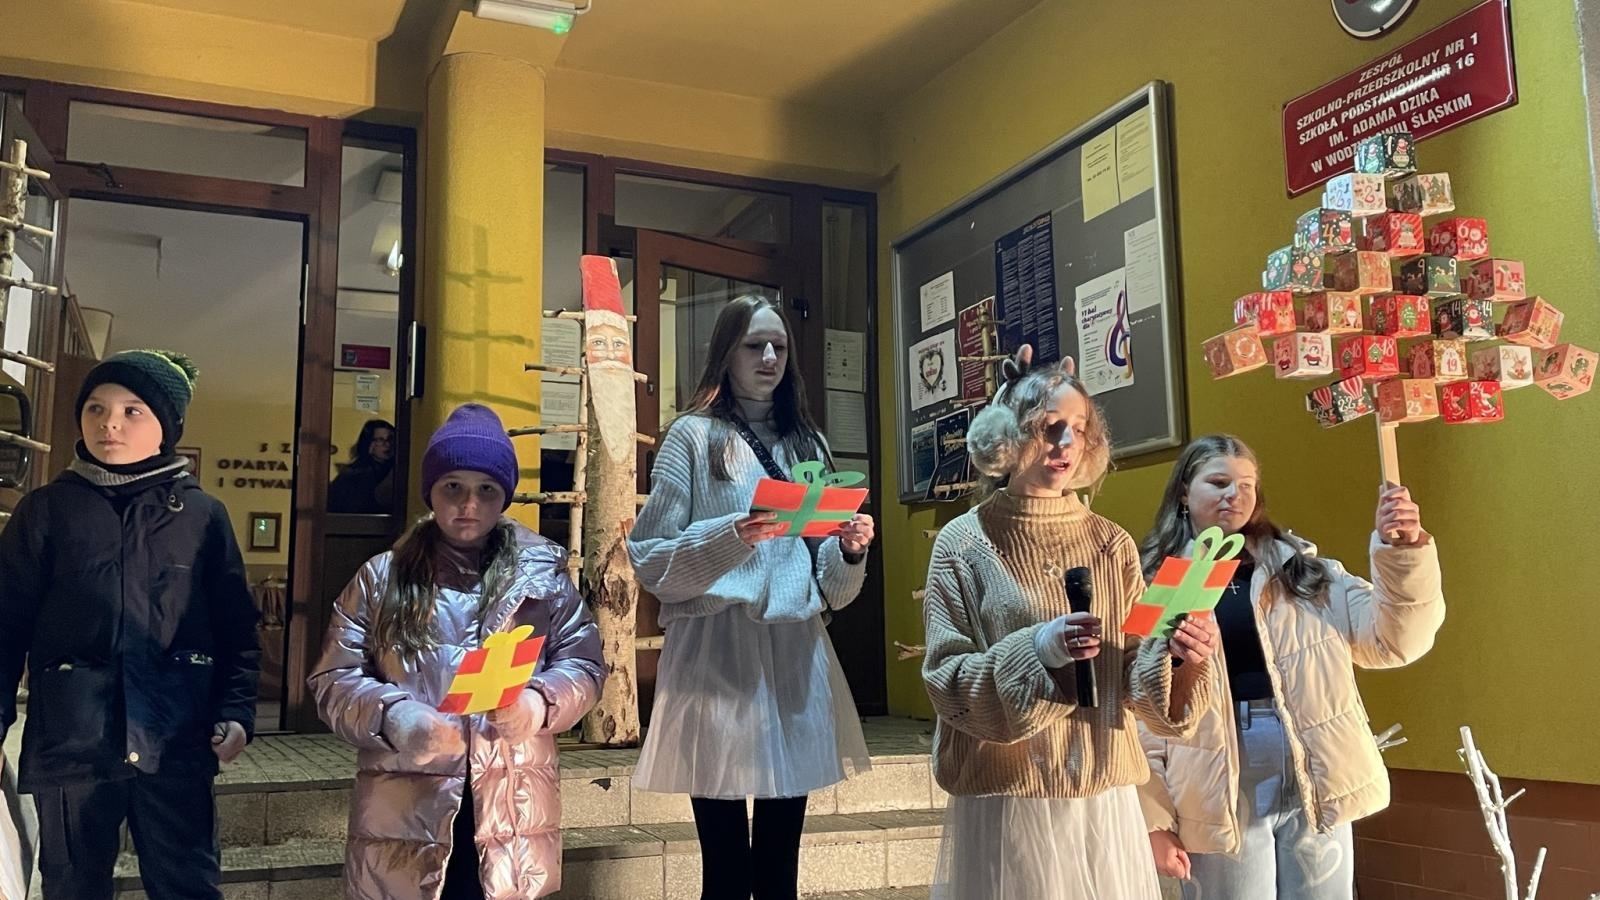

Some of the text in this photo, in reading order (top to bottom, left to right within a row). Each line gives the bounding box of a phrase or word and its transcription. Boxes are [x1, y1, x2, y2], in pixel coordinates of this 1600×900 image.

[1297, 32, 1478, 130] SZKOLNO-PRZEDSZKOLNY NR 1
[1359, 53, 1403, 83] ZESPÓŁ
[1299, 53, 1475, 145] SZKOŁA PODSTAWOWA NR 16
[1329, 87, 1440, 147] IM. ADAMA DZIKA
[1311, 161, 1323, 173] W
[1411, 93, 1472, 130] ŚLĄSKIM
[217, 459, 289, 472] OPARTA
[218, 477, 224, 488] I
